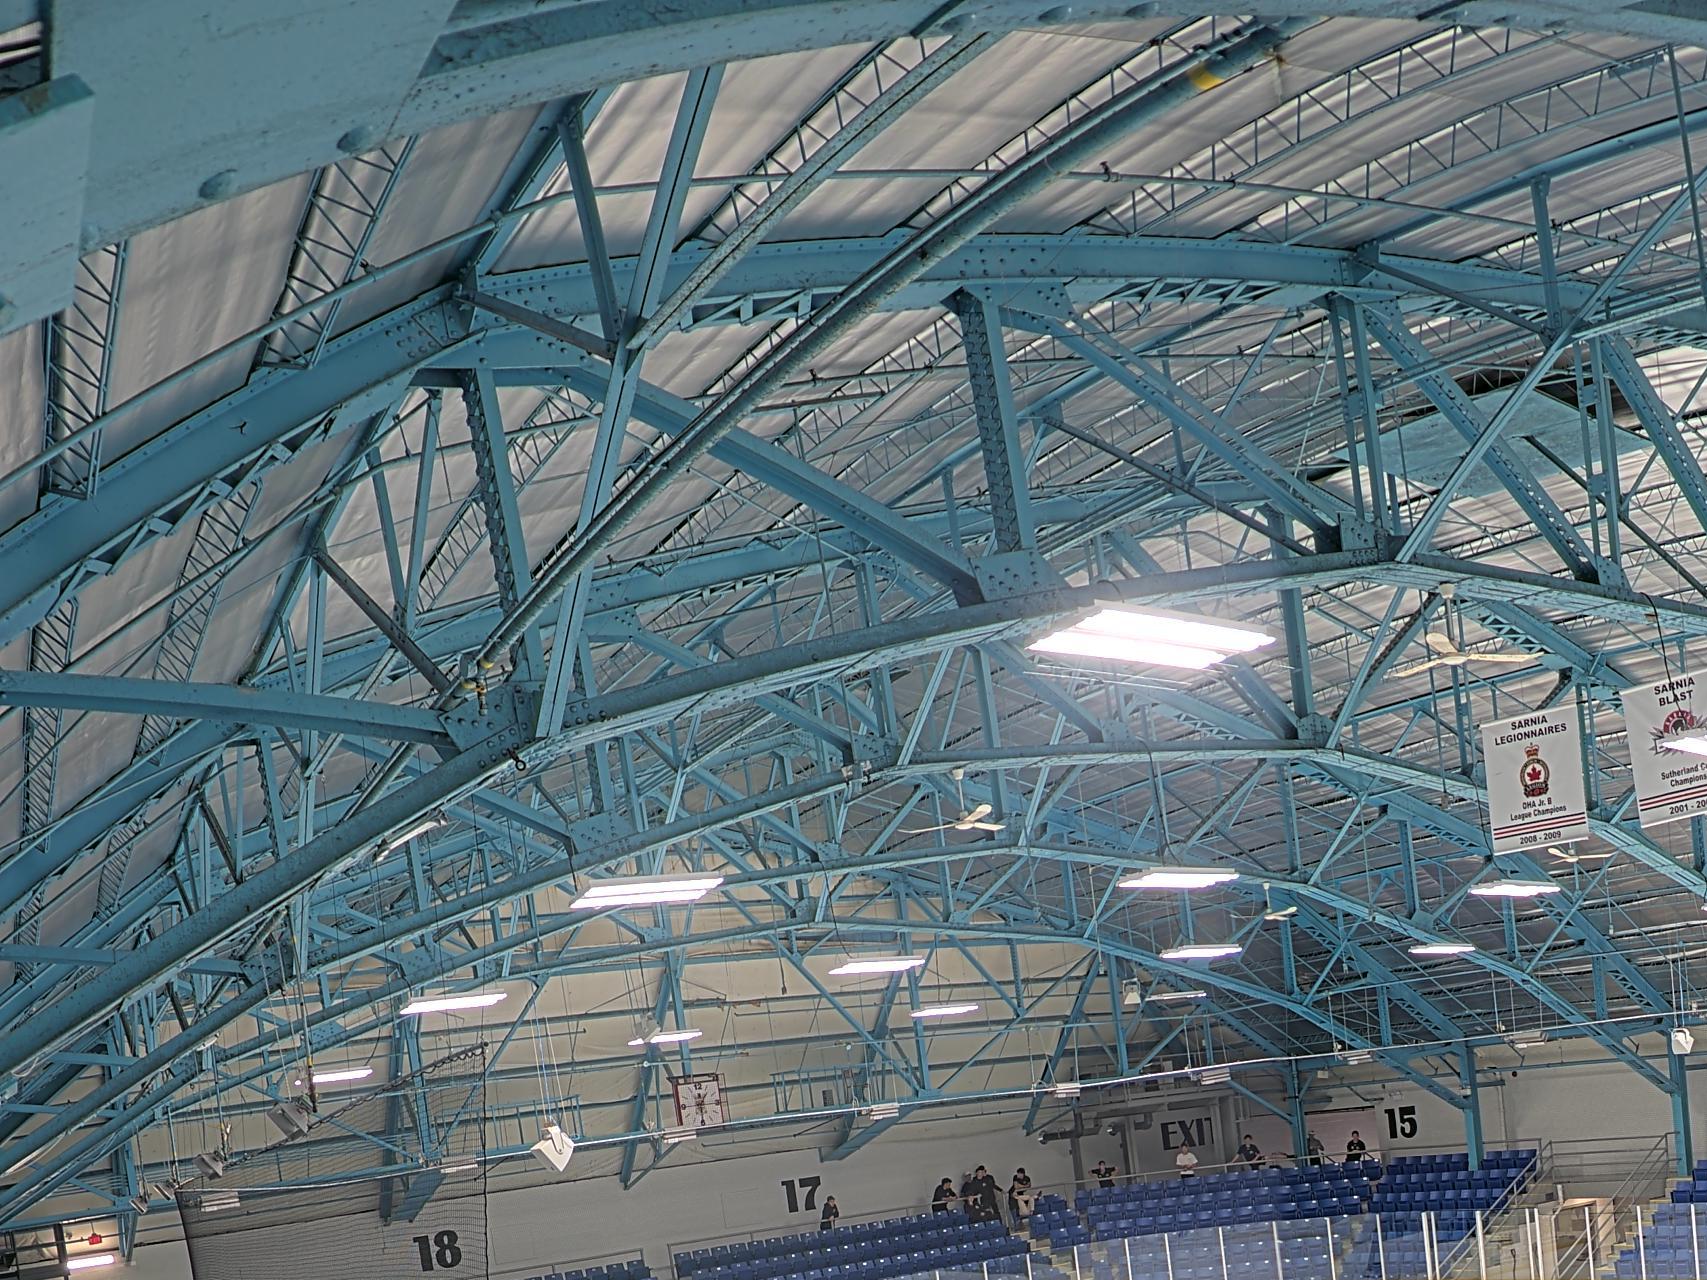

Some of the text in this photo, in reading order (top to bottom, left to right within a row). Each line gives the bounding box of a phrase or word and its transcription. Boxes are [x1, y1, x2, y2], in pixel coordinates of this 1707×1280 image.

[1654, 677, 1696, 695] SARNIA
[1659, 690, 1694, 707] BLAST
[1511, 715, 1548, 730] SARNIA
[1494, 723, 1567, 746] LEGIONNAIRES
[1661, 763, 1699, 780] Sutherland
[1670, 773, 1707, 787] Champions
[1510, 805, 1567, 821] League Champions
[1523, 800, 1536, 810] OHA
[1669, 804, 1688, 814] 2001
[1383, 1105, 1418, 1141] 15
[780, 1175, 822, 1214] 17
[413, 1230, 463, 1273] 18
